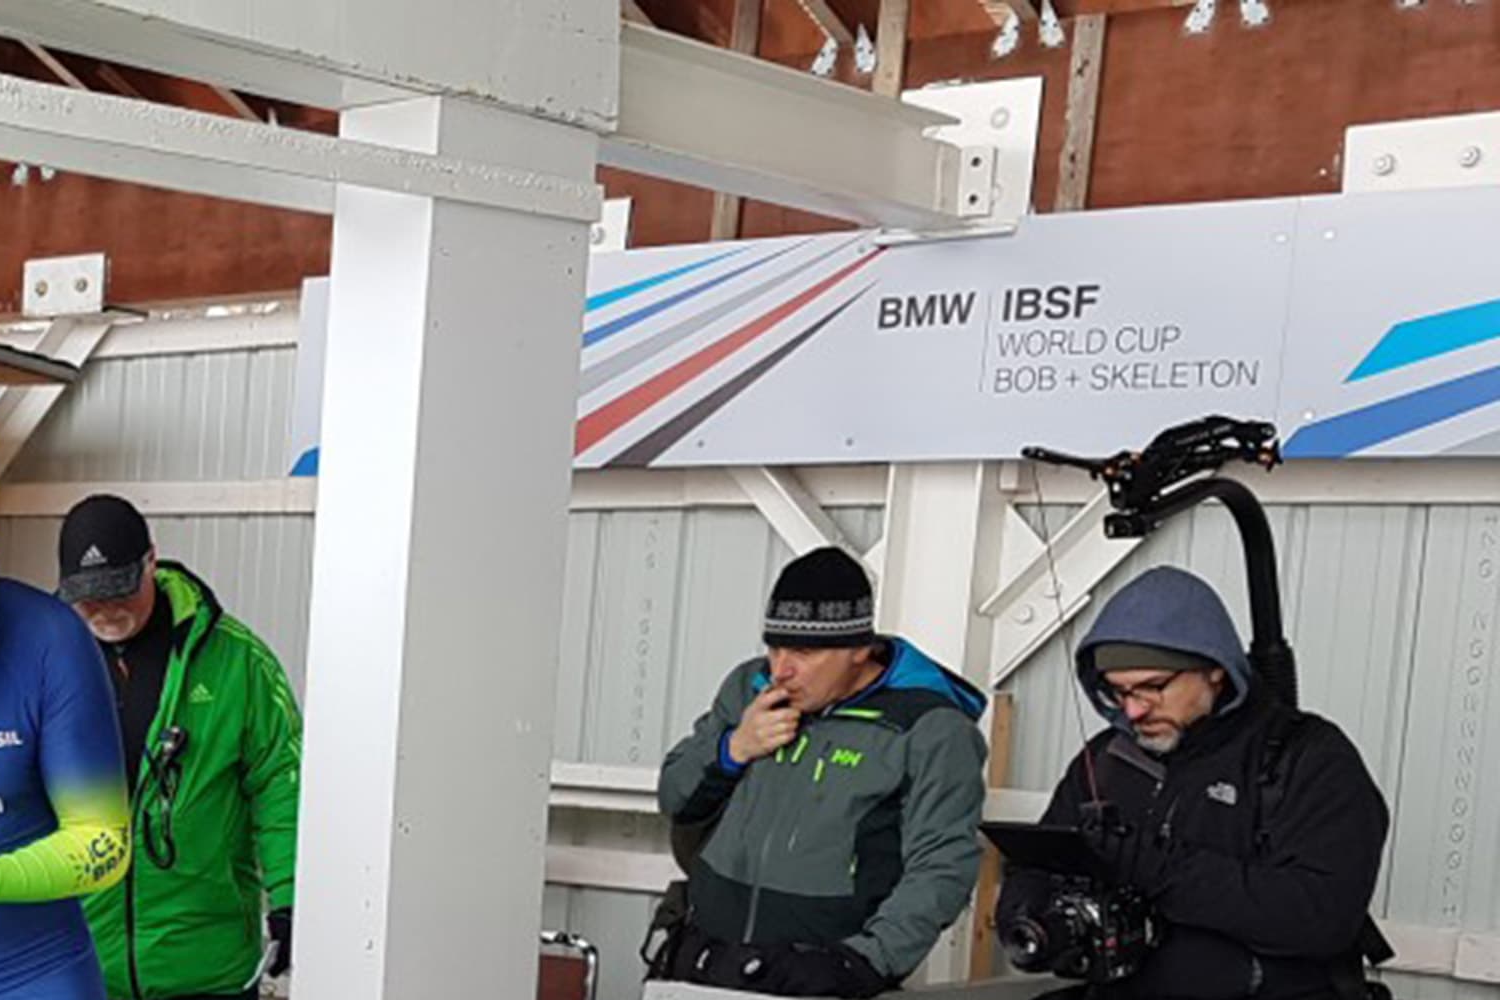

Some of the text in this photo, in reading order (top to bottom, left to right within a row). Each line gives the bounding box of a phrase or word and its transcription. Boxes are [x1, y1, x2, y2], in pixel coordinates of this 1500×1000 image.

[877, 285, 1100, 330] BMW IBSF
[997, 326, 1182, 357] WORLD CUP
[993, 360, 1260, 393] BOB + SKELETON
